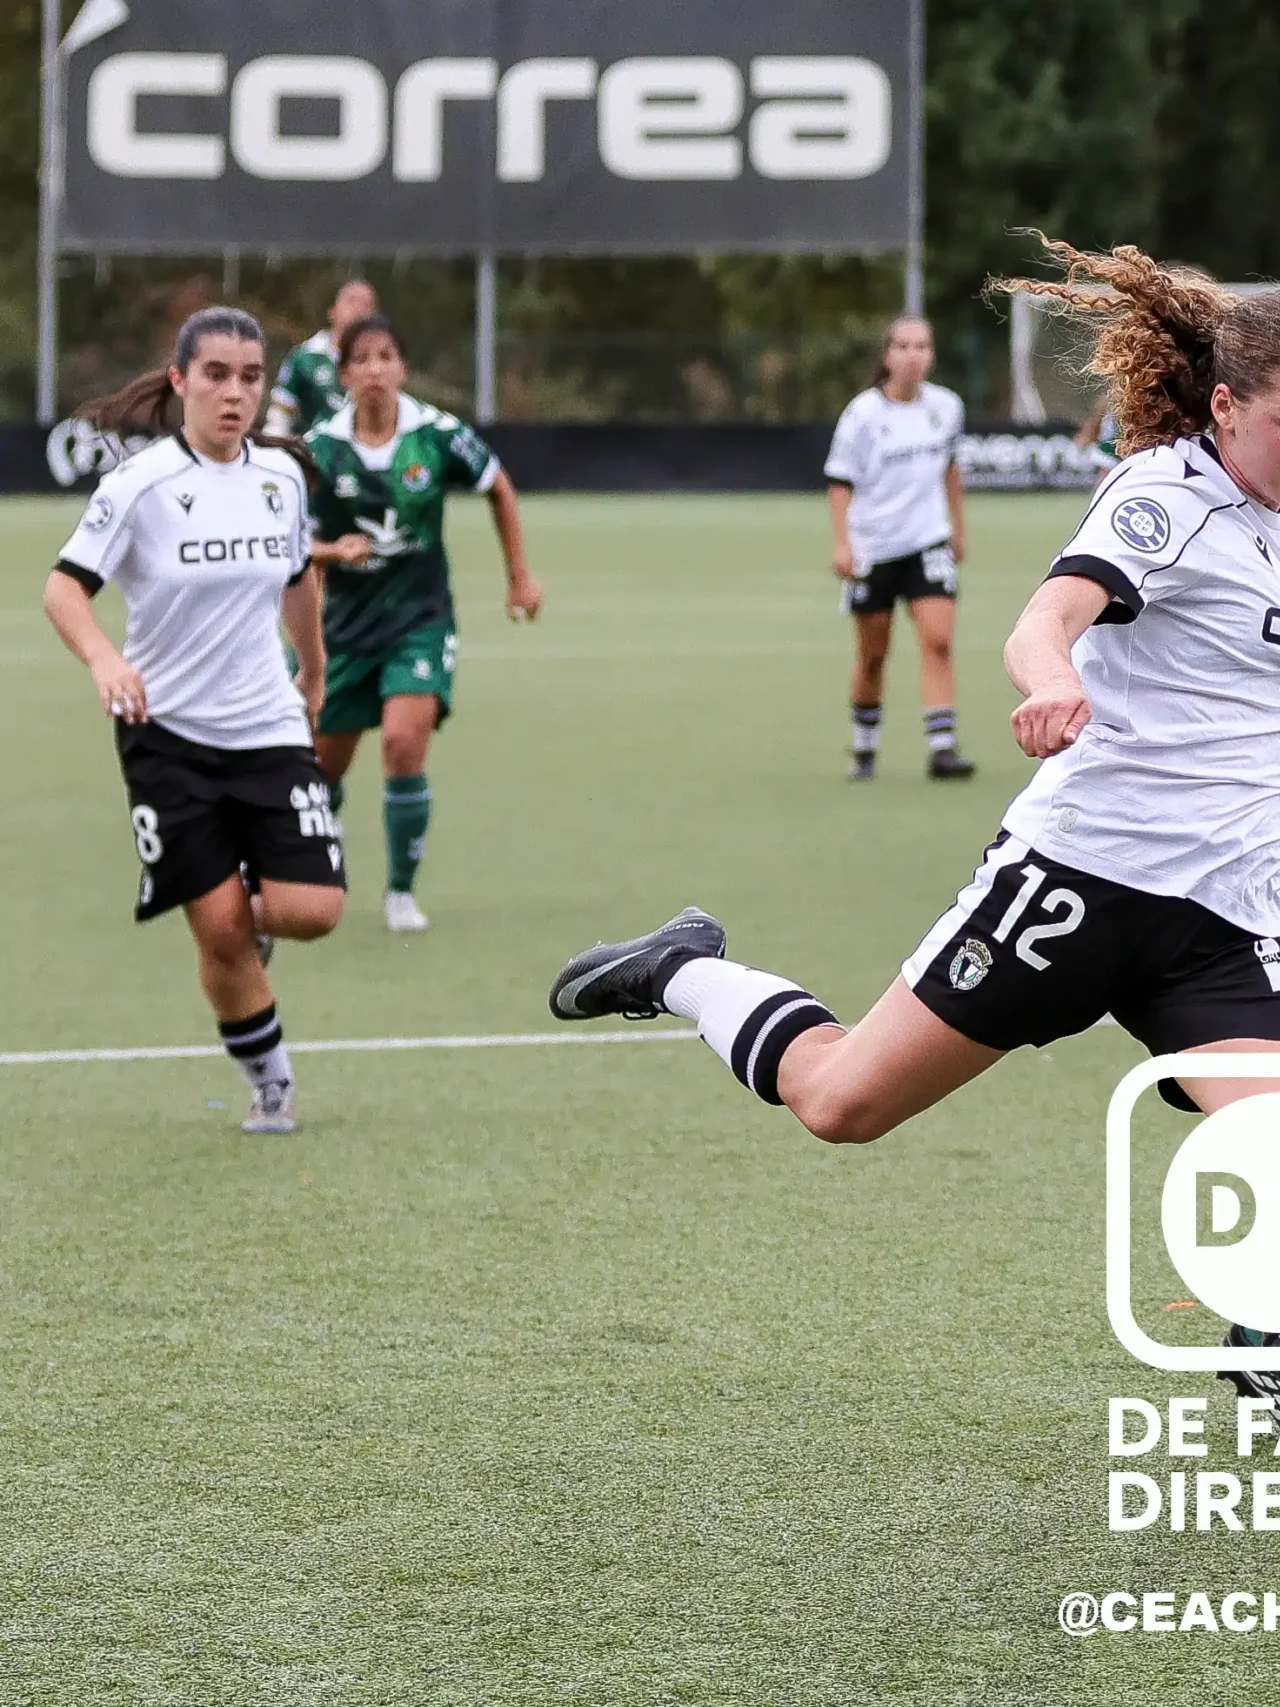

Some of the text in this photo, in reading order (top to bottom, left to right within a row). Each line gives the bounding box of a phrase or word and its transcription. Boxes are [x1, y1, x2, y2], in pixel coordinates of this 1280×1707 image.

[86, 51, 893, 182] correa
[132, 804, 164, 864] 8
[992, 863, 1086, 971] 12
